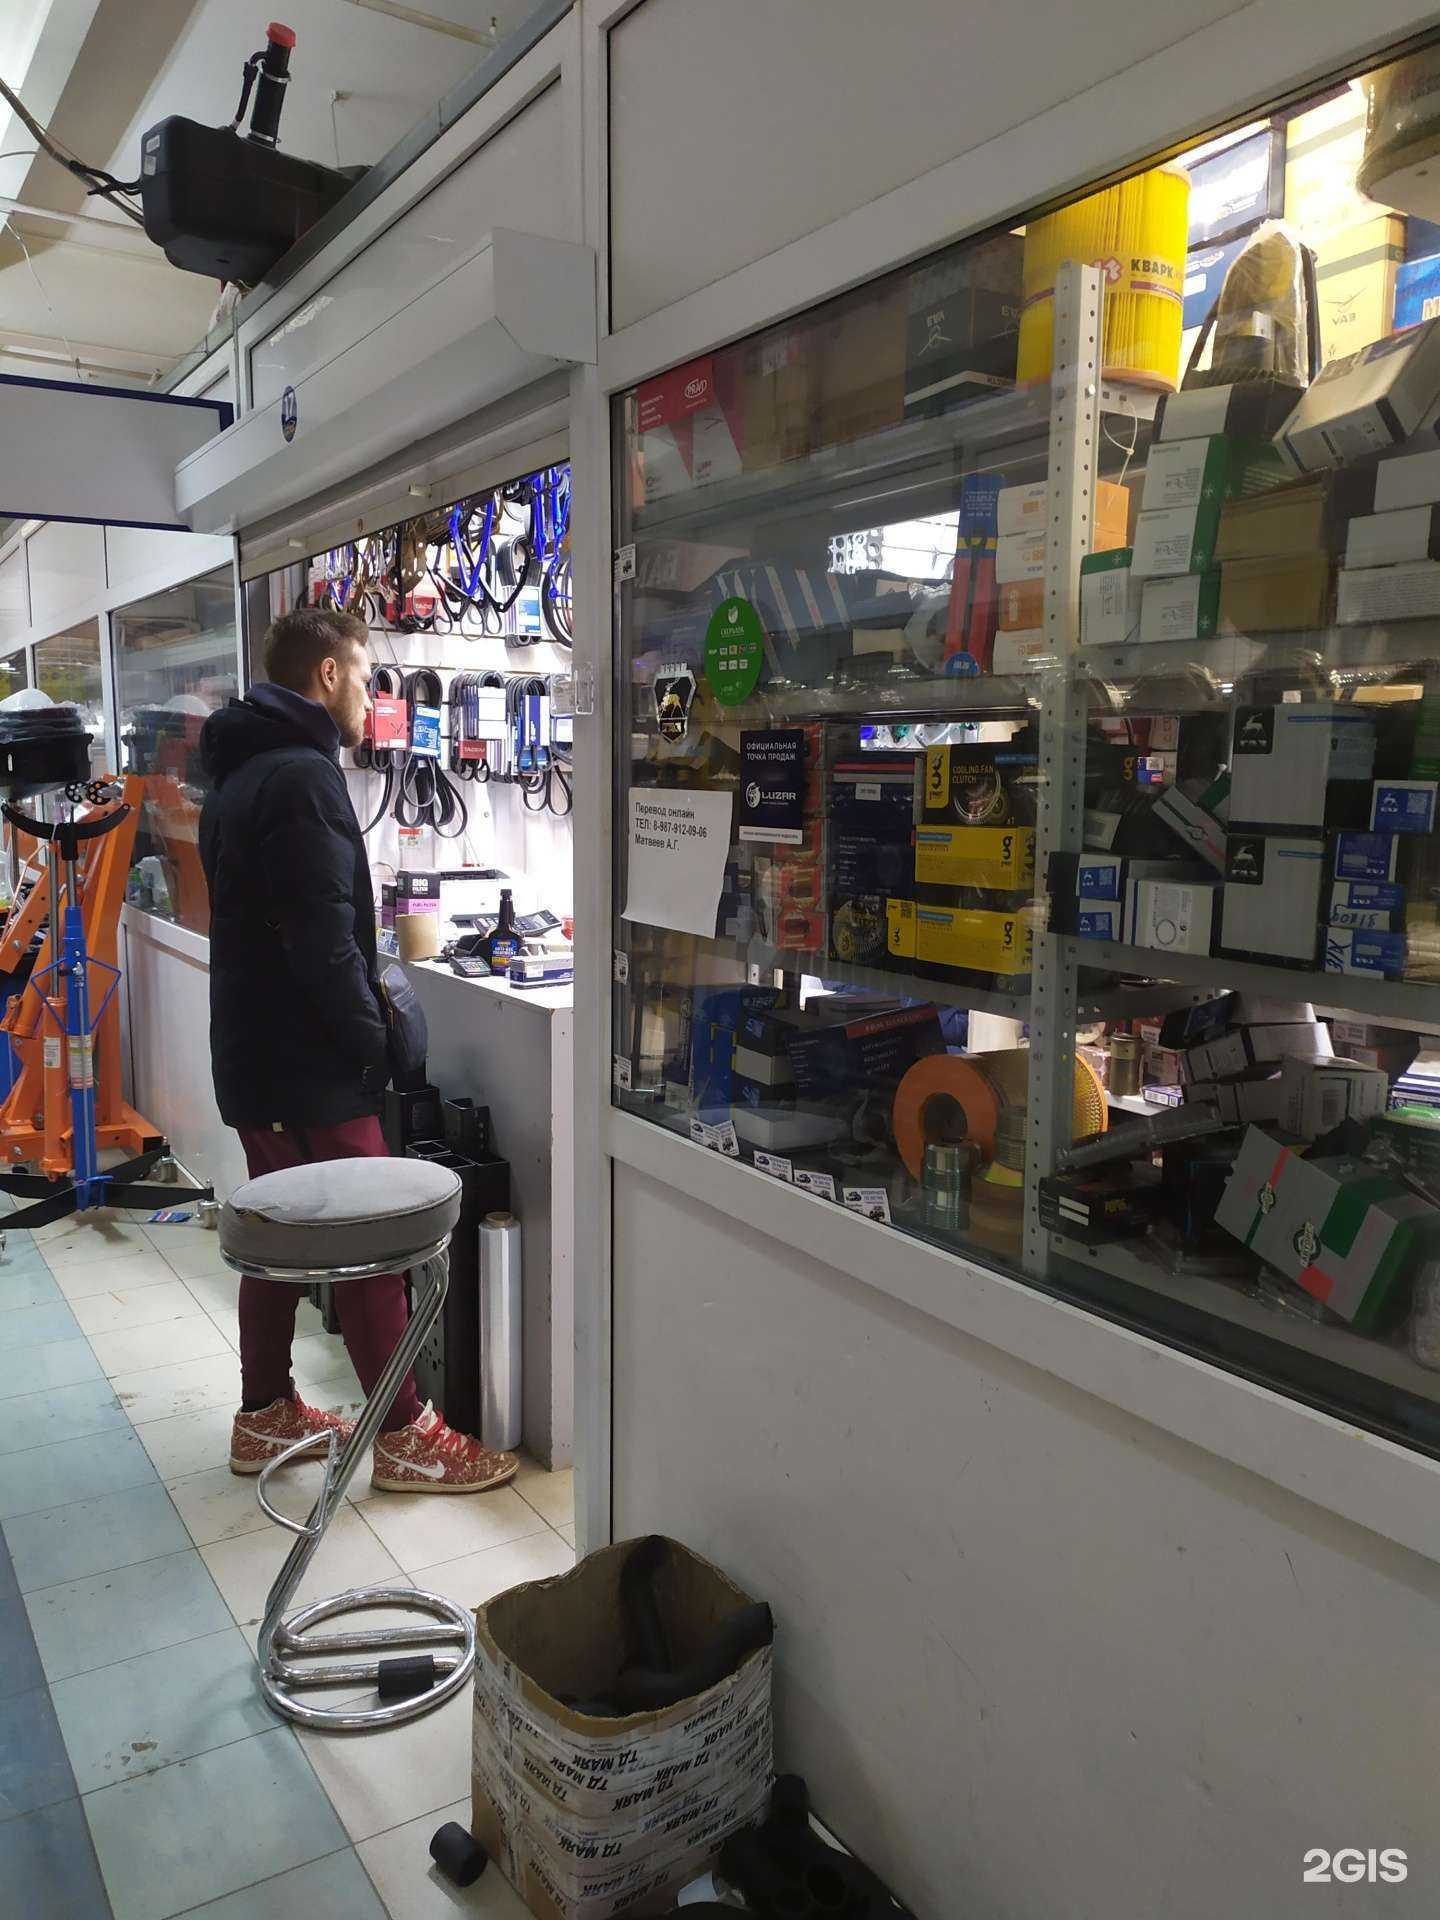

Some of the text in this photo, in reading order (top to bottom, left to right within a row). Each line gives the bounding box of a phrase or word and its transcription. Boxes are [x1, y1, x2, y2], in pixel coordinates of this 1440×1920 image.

[1131, 259, 1174, 278] КВАРК
[746, 742, 797, 751] ОФИЦИАЛЬНАЯ
[747, 753, 796, 761] ТОЧКА ПРОДАЖ
[952, 775, 977, 784] CLUTCH
[761, 791, 797, 801] LUZAR
[635, 802, 695, 819] Перевод онлайн
[635, 818, 652, 830] ТЕЛ:
[635, 834, 680, 851] Матвеев А.Г.
[412, 878, 429, 887] BIG
[572, 1749, 638, 1771] ТД МАЯК
[693, 1750, 711, 1768] ТД
[550, 1756, 609, 1791] ТД МАЯК
[652, 1759, 693, 1784] МАЯК
[551, 1784, 569, 1802] ТД
[611, 1777, 675, 1812] ТД МАЯК
[662, 1796, 719, 1834] ТД МАЯК
[558, 1836, 622, 1859] ТД МАЯК
